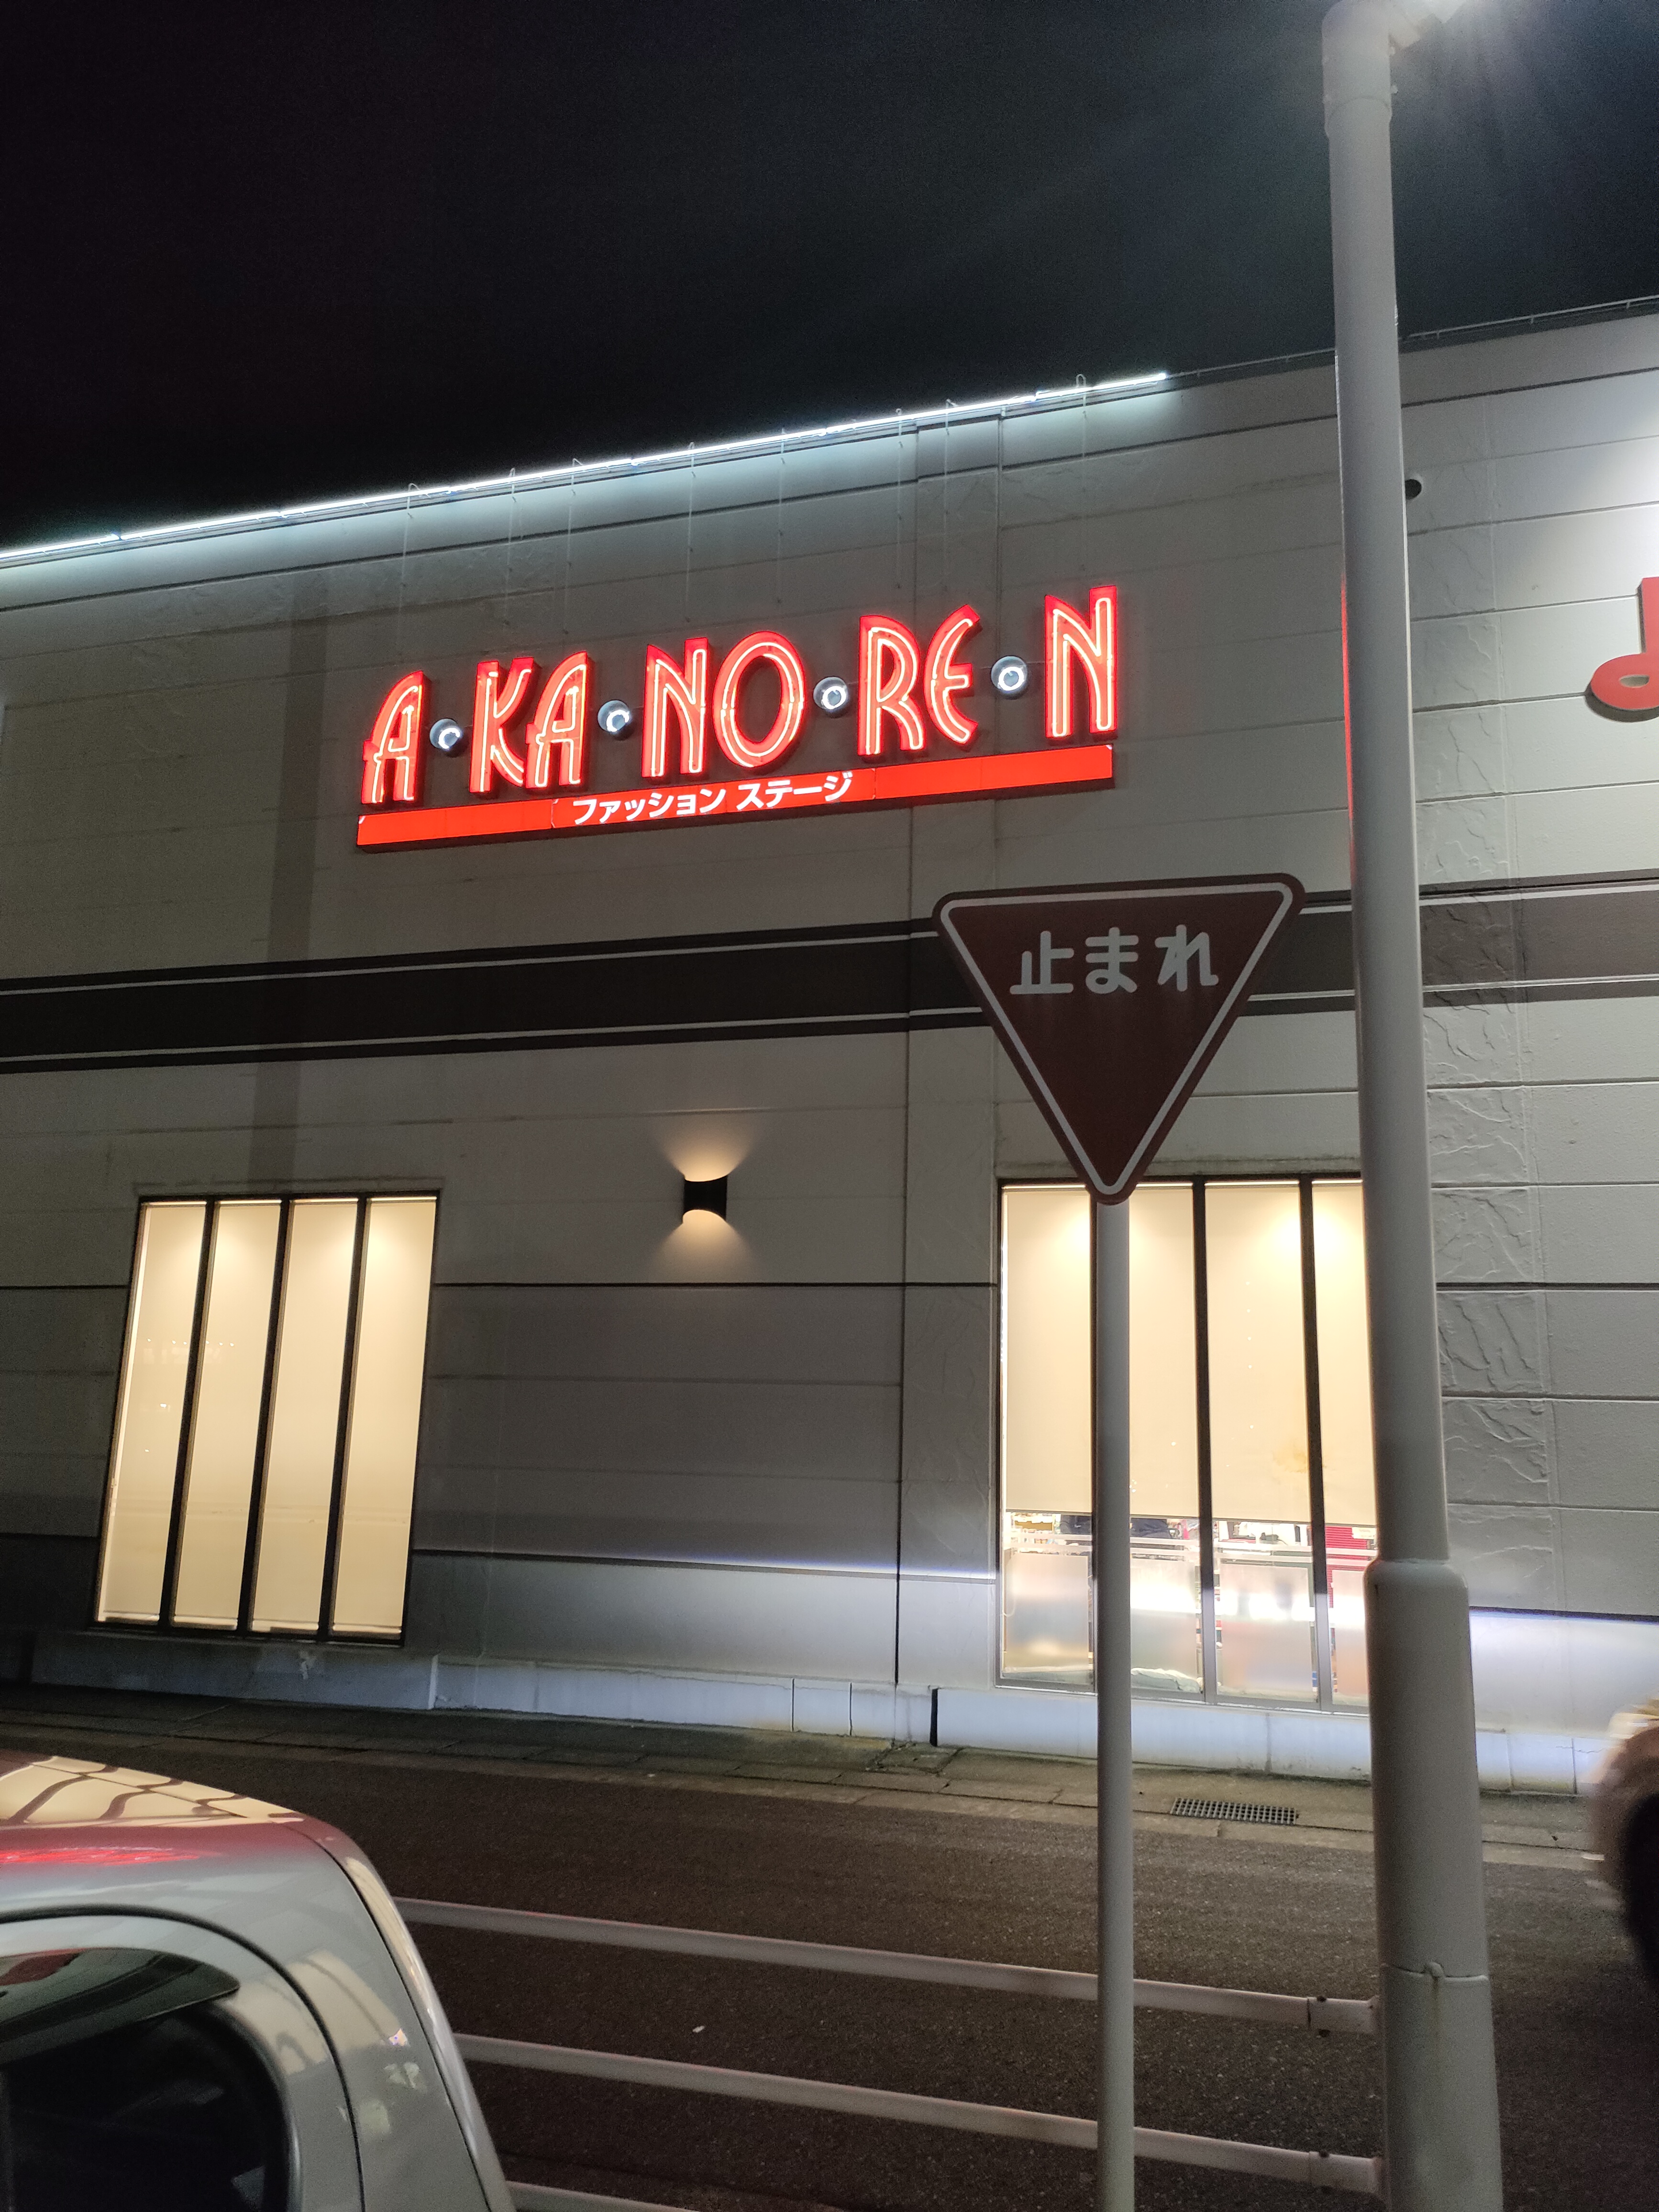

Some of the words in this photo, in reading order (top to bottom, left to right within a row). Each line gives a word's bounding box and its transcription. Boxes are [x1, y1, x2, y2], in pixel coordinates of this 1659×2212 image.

[573, 788, 727, 825] ファッション
[736, 771, 853, 812] ステージ
[1010, 924, 1219, 995] 止まれ
